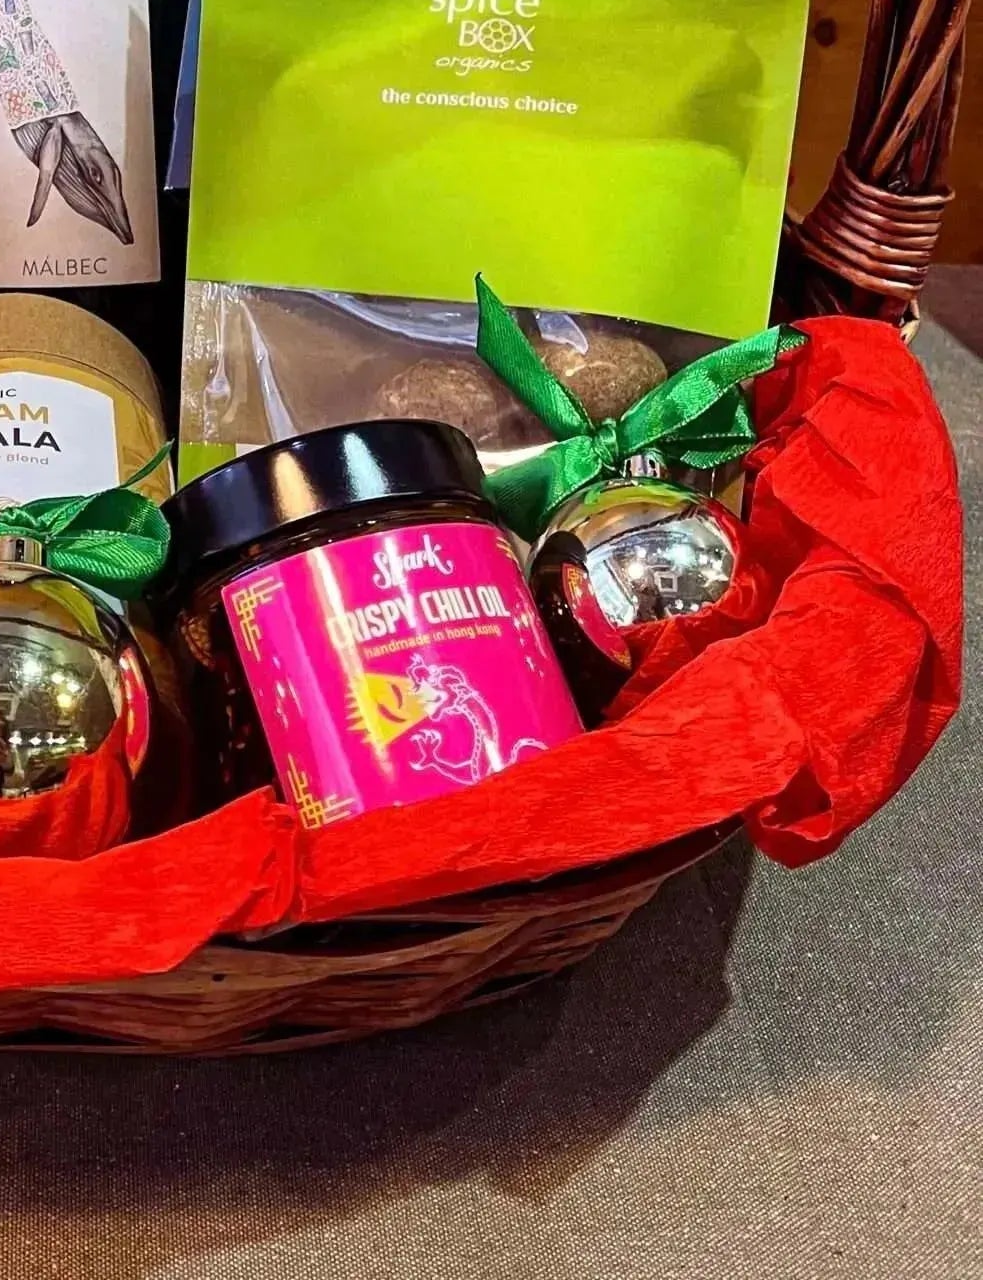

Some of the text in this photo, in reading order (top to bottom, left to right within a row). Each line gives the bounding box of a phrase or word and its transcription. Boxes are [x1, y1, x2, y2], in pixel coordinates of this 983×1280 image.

[458, 18, 535, 53] BOX
[435, 54, 534, 76] organics
[381, 87, 578, 115] the conscious choice
[22, 255, 108, 276] MÁLBEC
[6, 452, 49, 466] Blend
[327, 585, 511, 650] CRISPY CHILI OIL
[364, 622, 502, 658] handmade in hong kong
